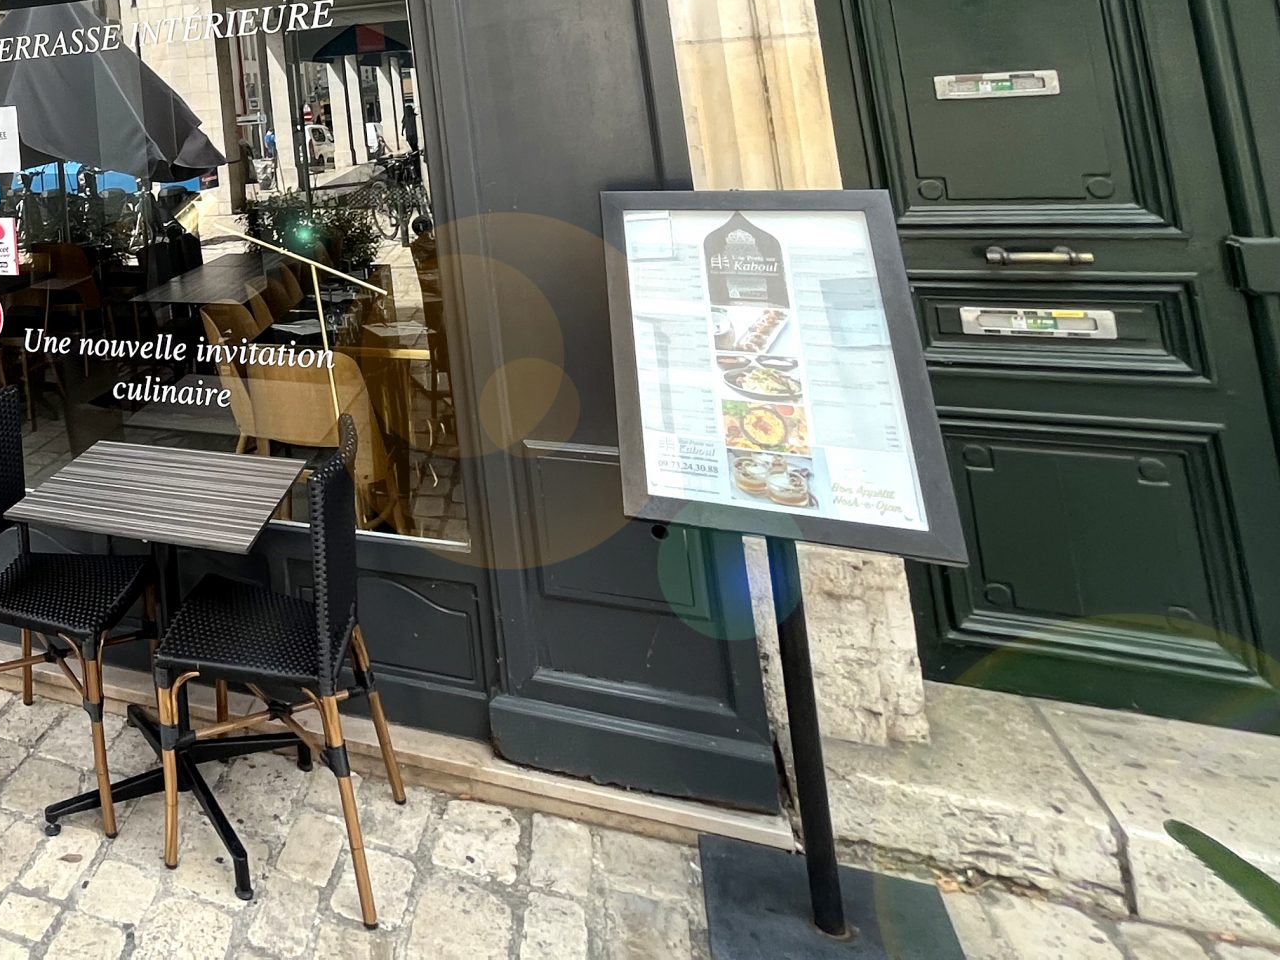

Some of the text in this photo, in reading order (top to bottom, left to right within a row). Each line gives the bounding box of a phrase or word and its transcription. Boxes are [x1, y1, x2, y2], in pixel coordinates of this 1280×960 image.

[130, 0, 335, 49] INTÉRIEURE
[733, 261, 778, 272] Kaboul
[23, 327, 335, 370] Une nouvelle invitation
[112, 376, 232, 408] culinaire
